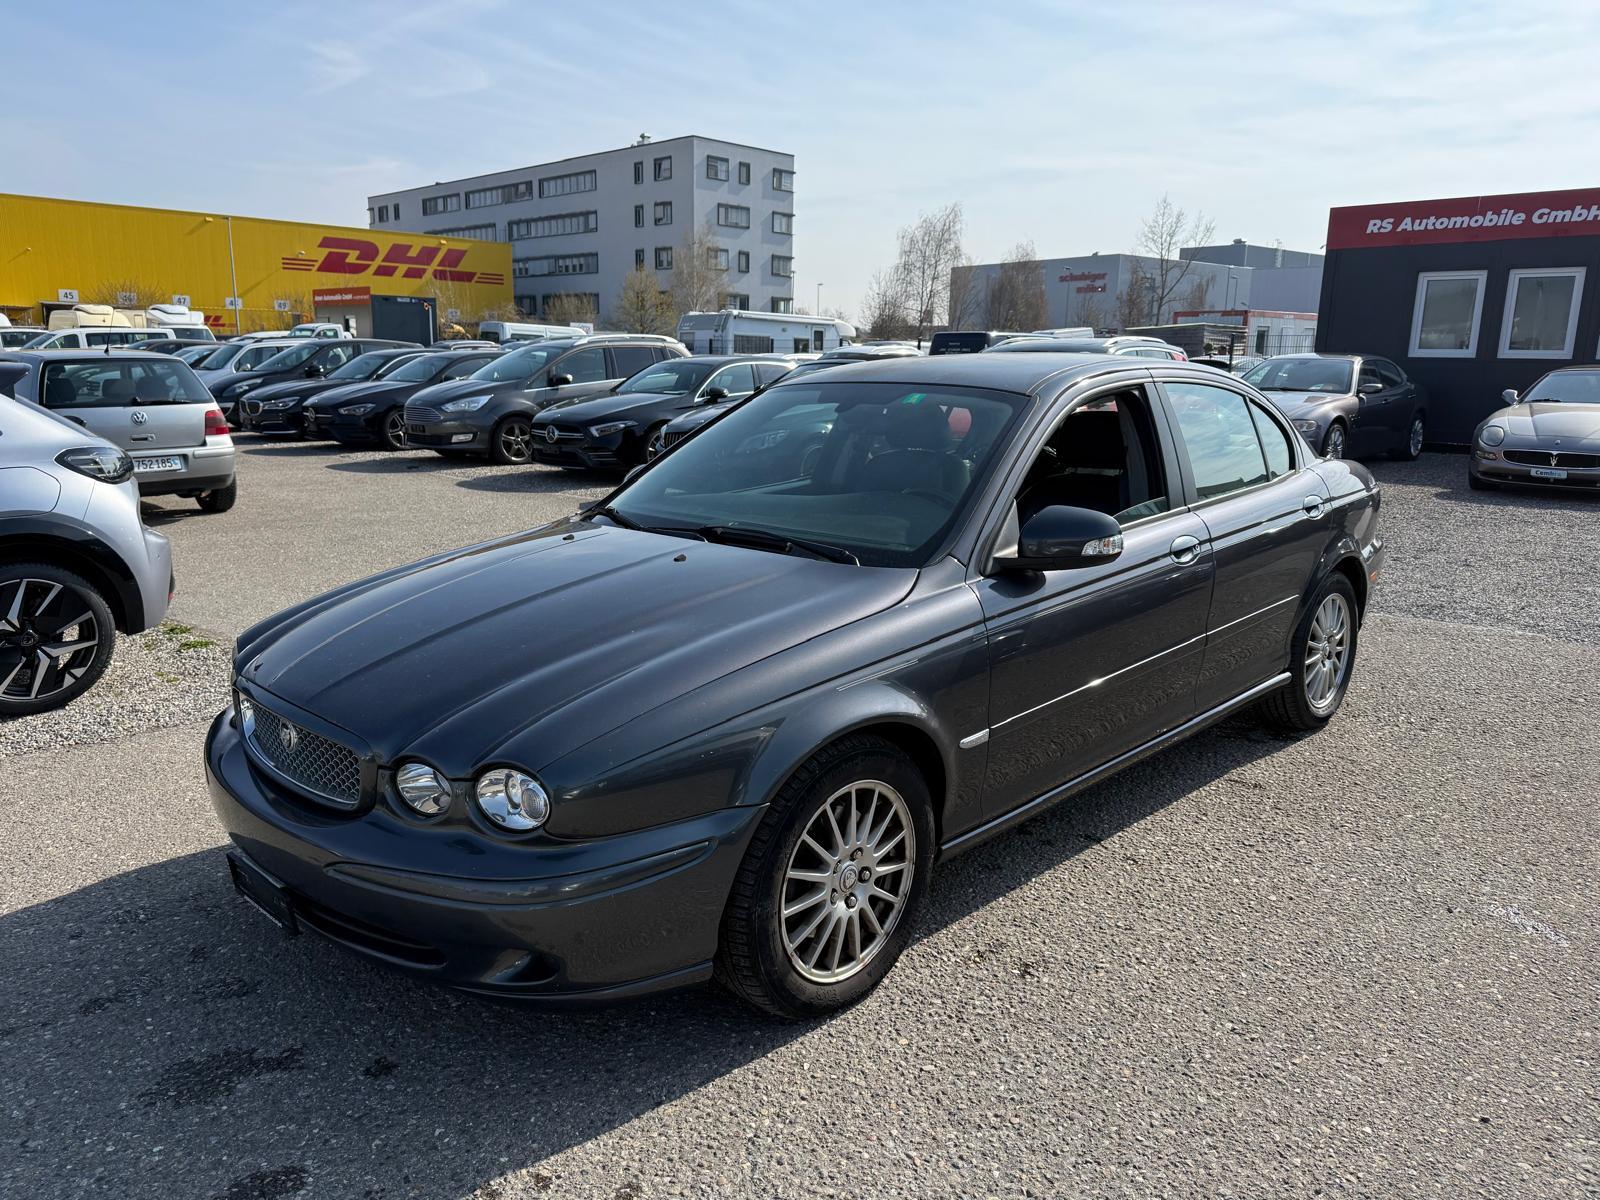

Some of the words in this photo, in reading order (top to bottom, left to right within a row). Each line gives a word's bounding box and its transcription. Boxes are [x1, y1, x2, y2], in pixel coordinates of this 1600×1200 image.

[1366, 218, 1394, 234] RS
[1396, 208, 1526, 232] Automobile
[1532, 205, 1600, 225] GmbH
[317, 236, 477, 283] DHL
[63, 291, 74, 299] 45
[177, 297, 186, 305] 47
[277, 302, 287, 310] 49
